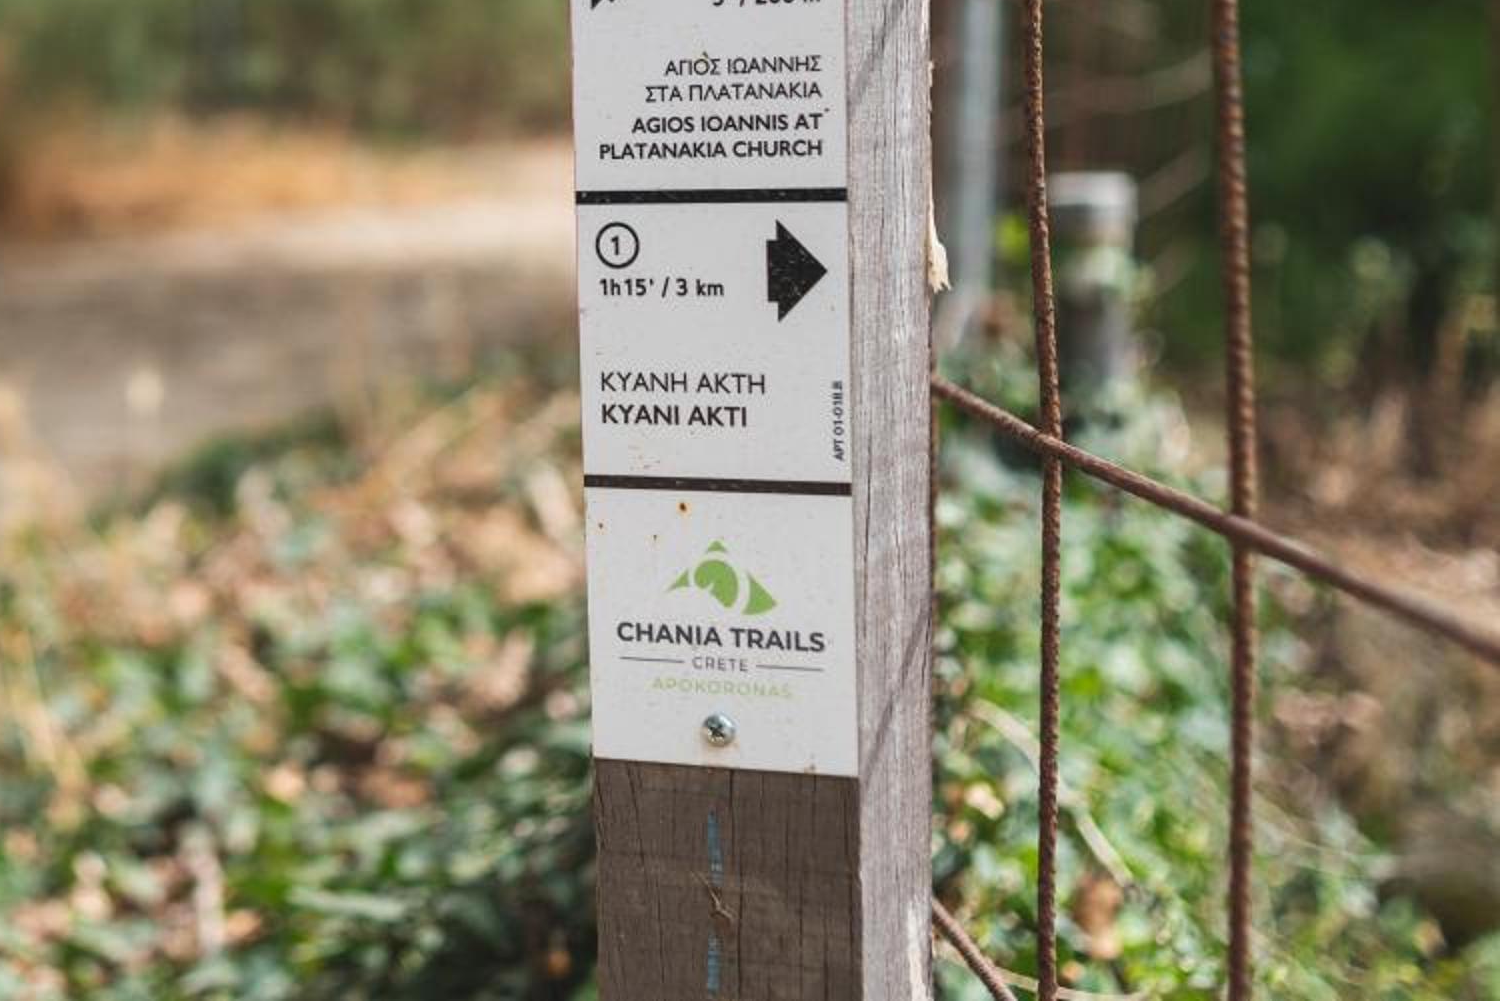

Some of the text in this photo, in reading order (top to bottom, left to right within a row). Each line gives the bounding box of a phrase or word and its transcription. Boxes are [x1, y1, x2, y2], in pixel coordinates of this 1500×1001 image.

[727, 54, 822, 75] ΙΩΑΝΝΗΣ
[645, 81, 823, 104] ΣΤΑ ΠΛΑΤΑΝΑΚΙΑ
[631, 112, 823, 134] AGIOS IOANNIS AT
[599, 139, 823, 160] PLATANAKIA CHURCH
[610, 235, 620, 256] 1
[599, 276, 725, 299] 1h15' / 3 km
[600, 371, 766, 395] ΚΥΑΝΗ ΑΚΤΗ
[601, 403, 747, 428] KYANI AKTI
[616, 621, 826, 653] CHANIA TRAILS
[691, 656, 748, 673] CRETE
